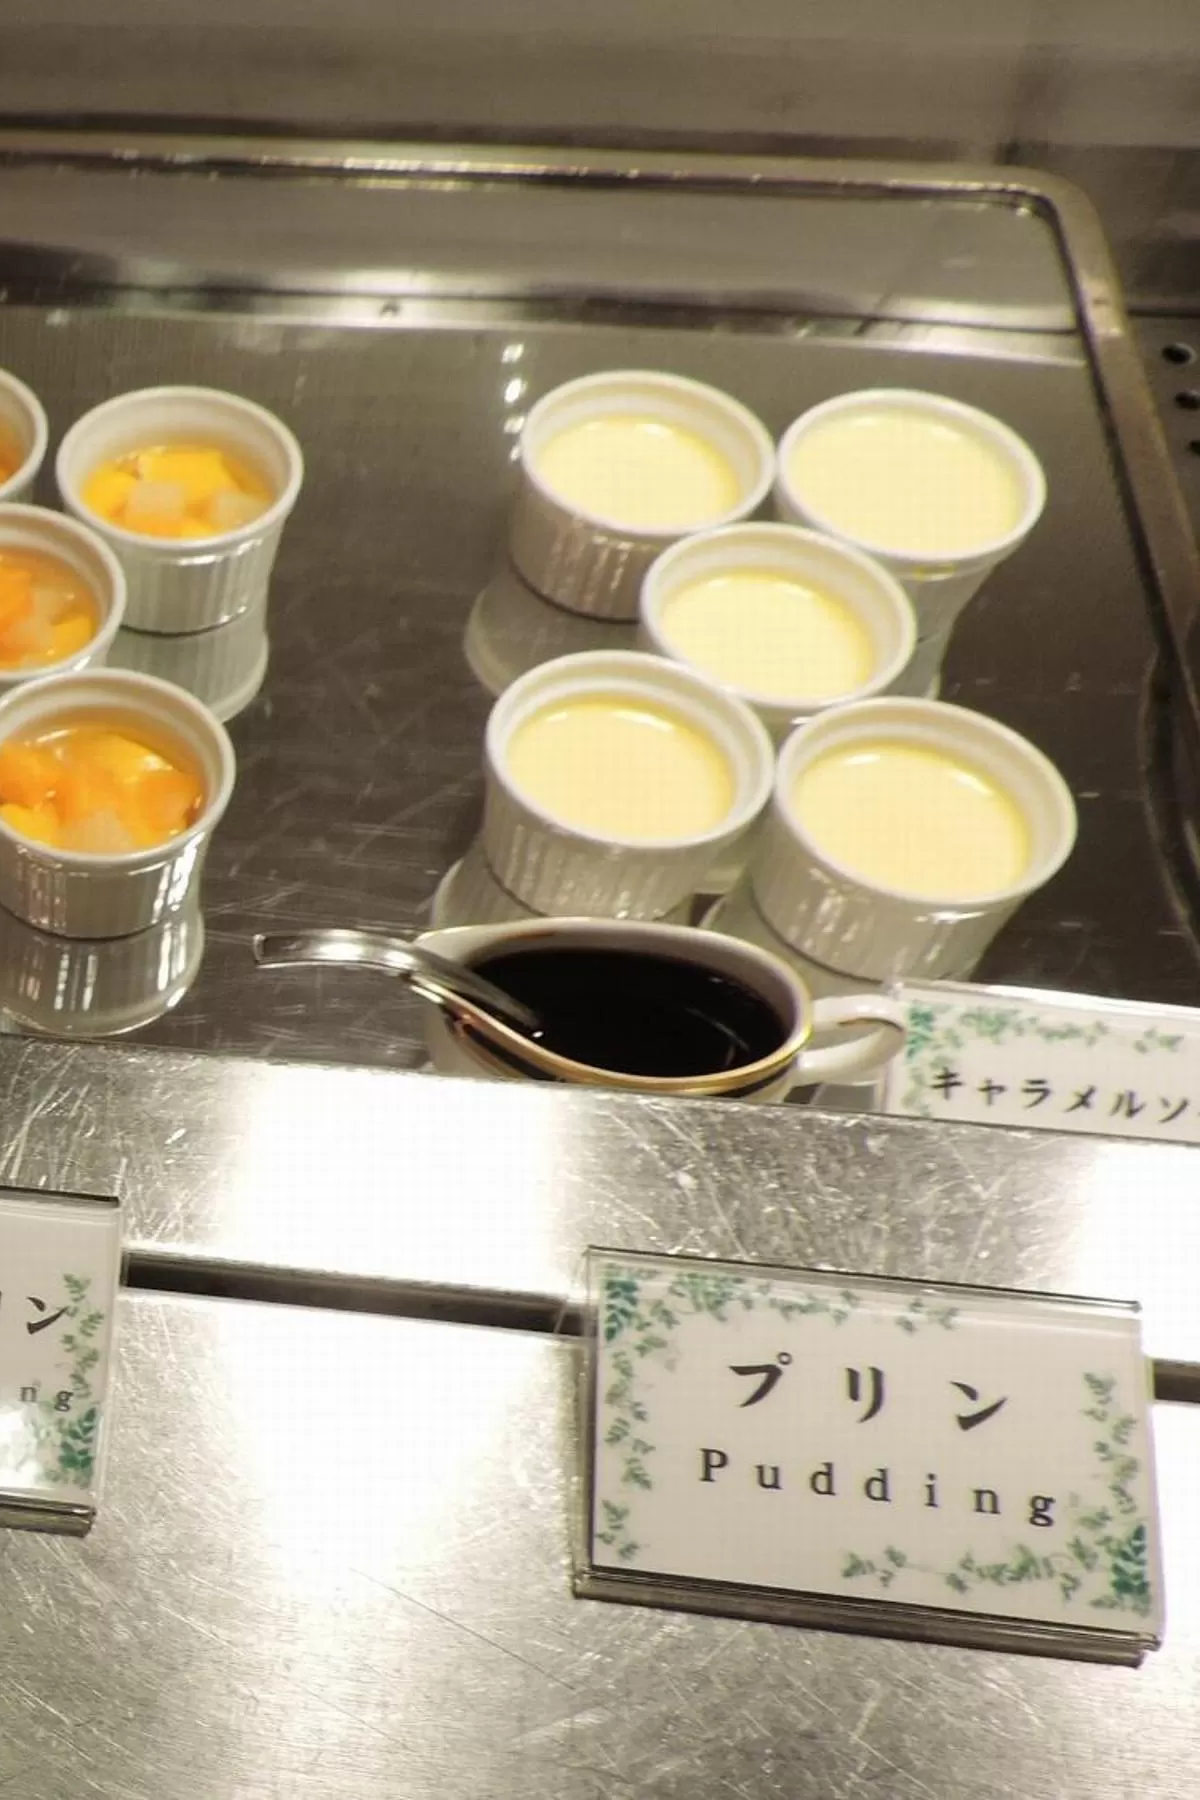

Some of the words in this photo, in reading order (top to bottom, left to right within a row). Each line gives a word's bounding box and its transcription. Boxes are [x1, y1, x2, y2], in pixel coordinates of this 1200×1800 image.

[931, 1066, 1200, 1123] キャラメルソ
[728, 1351, 1007, 1431] プリン
[699, 1447, 1056, 1527] Pudding
